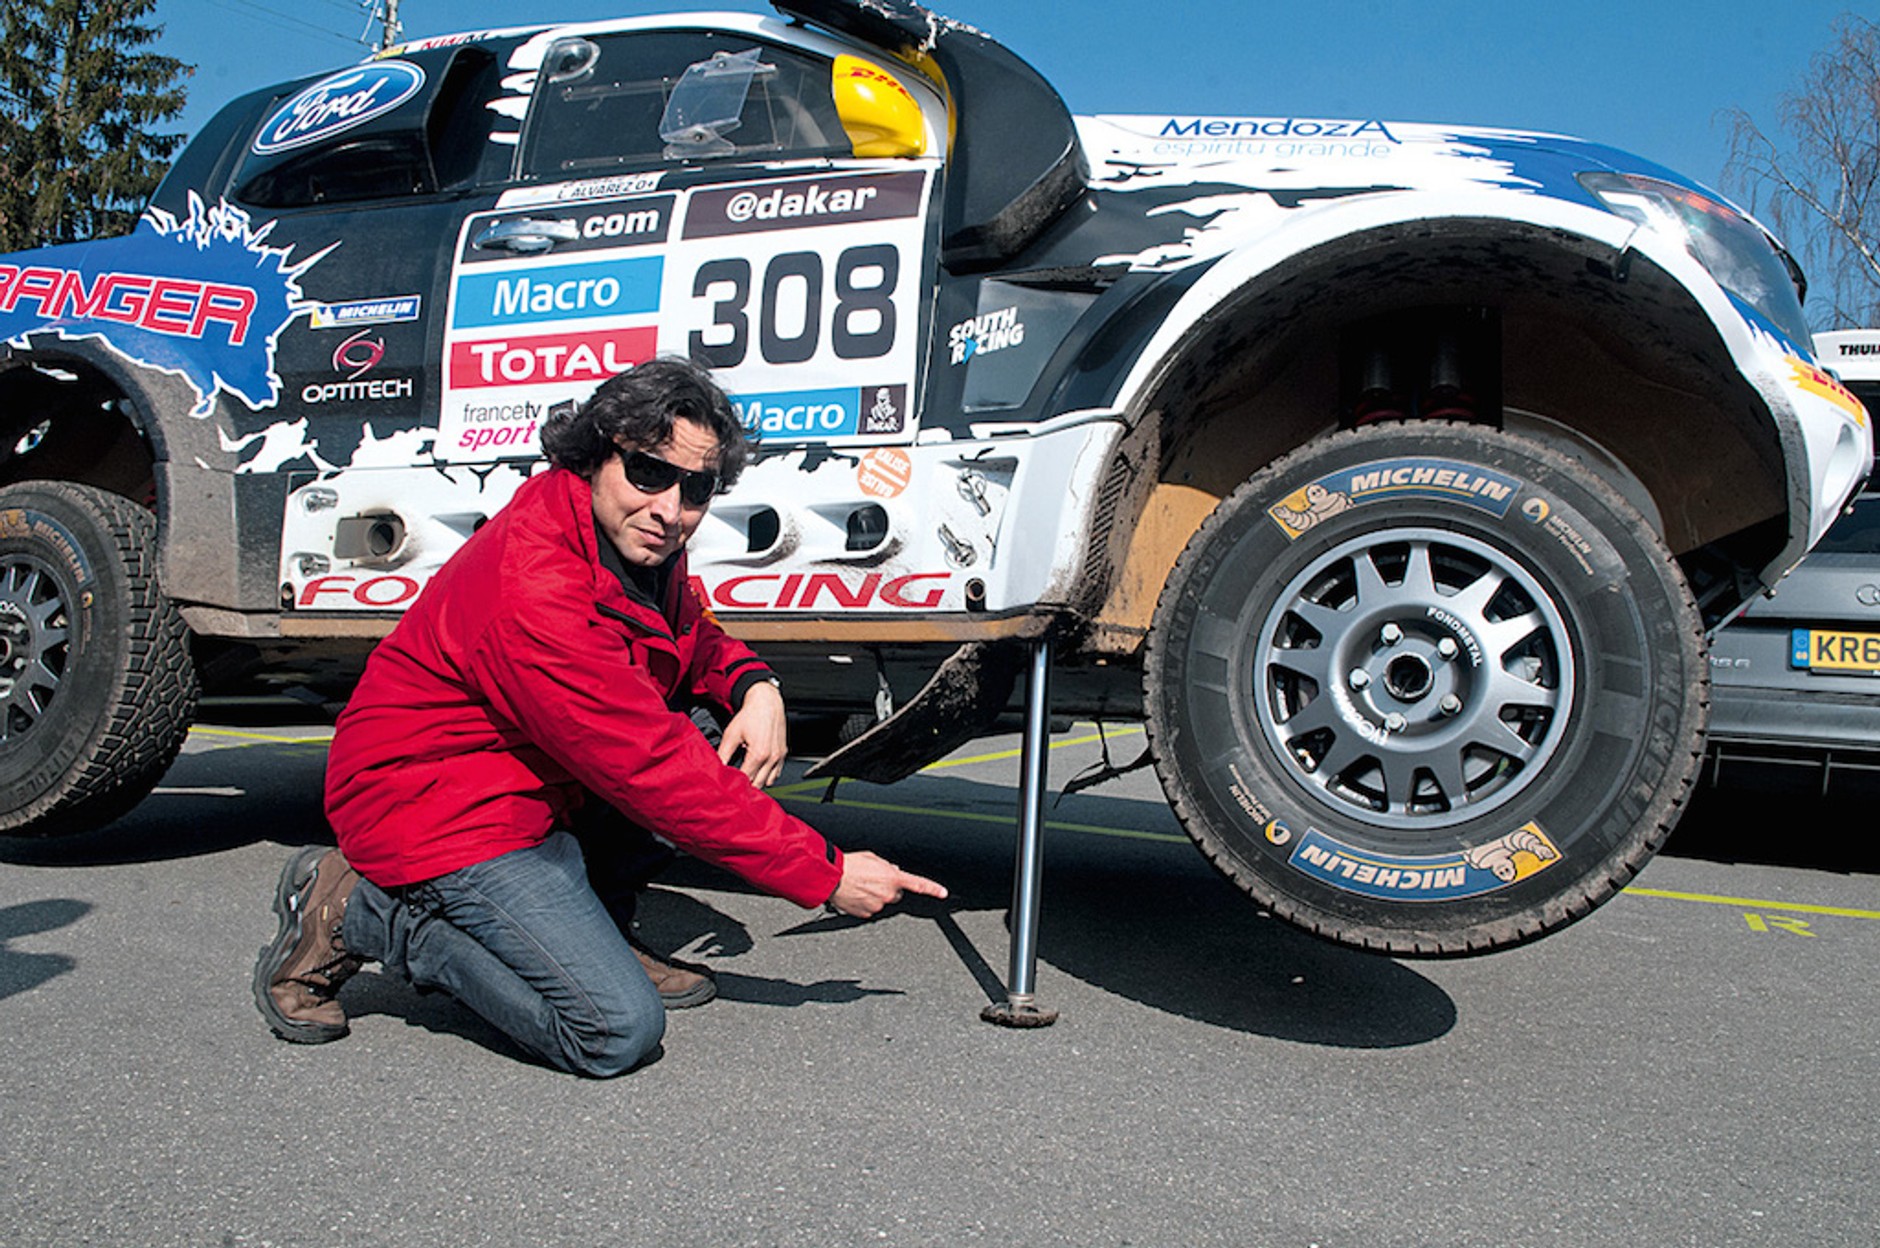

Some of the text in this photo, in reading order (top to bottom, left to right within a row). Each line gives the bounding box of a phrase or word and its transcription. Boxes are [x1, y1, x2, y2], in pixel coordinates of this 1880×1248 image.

[273, 73, 389, 142] Ford
[1275, 139, 1391, 158] grande
[726, 185, 877, 222] @dakar
[338, 302, 413, 318] MICHELIN
[492, 277, 621, 317] Macro
[688, 243, 900, 370] 308
[948, 306, 1017, 348] SOUTH
[470, 341, 635, 383] TOTAL
[1838, 344, 1880, 356] THUL
[301, 378, 413, 404] OPTITECH
[731, 401, 845, 432] Macro
[458, 421, 537, 452] sport
[1350, 467, 1512, 501] MICHELIN
[33, 518, 87, 584] MICHELIN
[1549, 515, 1593, 554] MICHELIN
[298, 572, 952, 608] FO ACING
[1427, 607, 1483, 668] FONDMETAL
[1228, 784, 1267, 826] MICHELIN
[1299, 843, 1466, 888] MICHELIN
